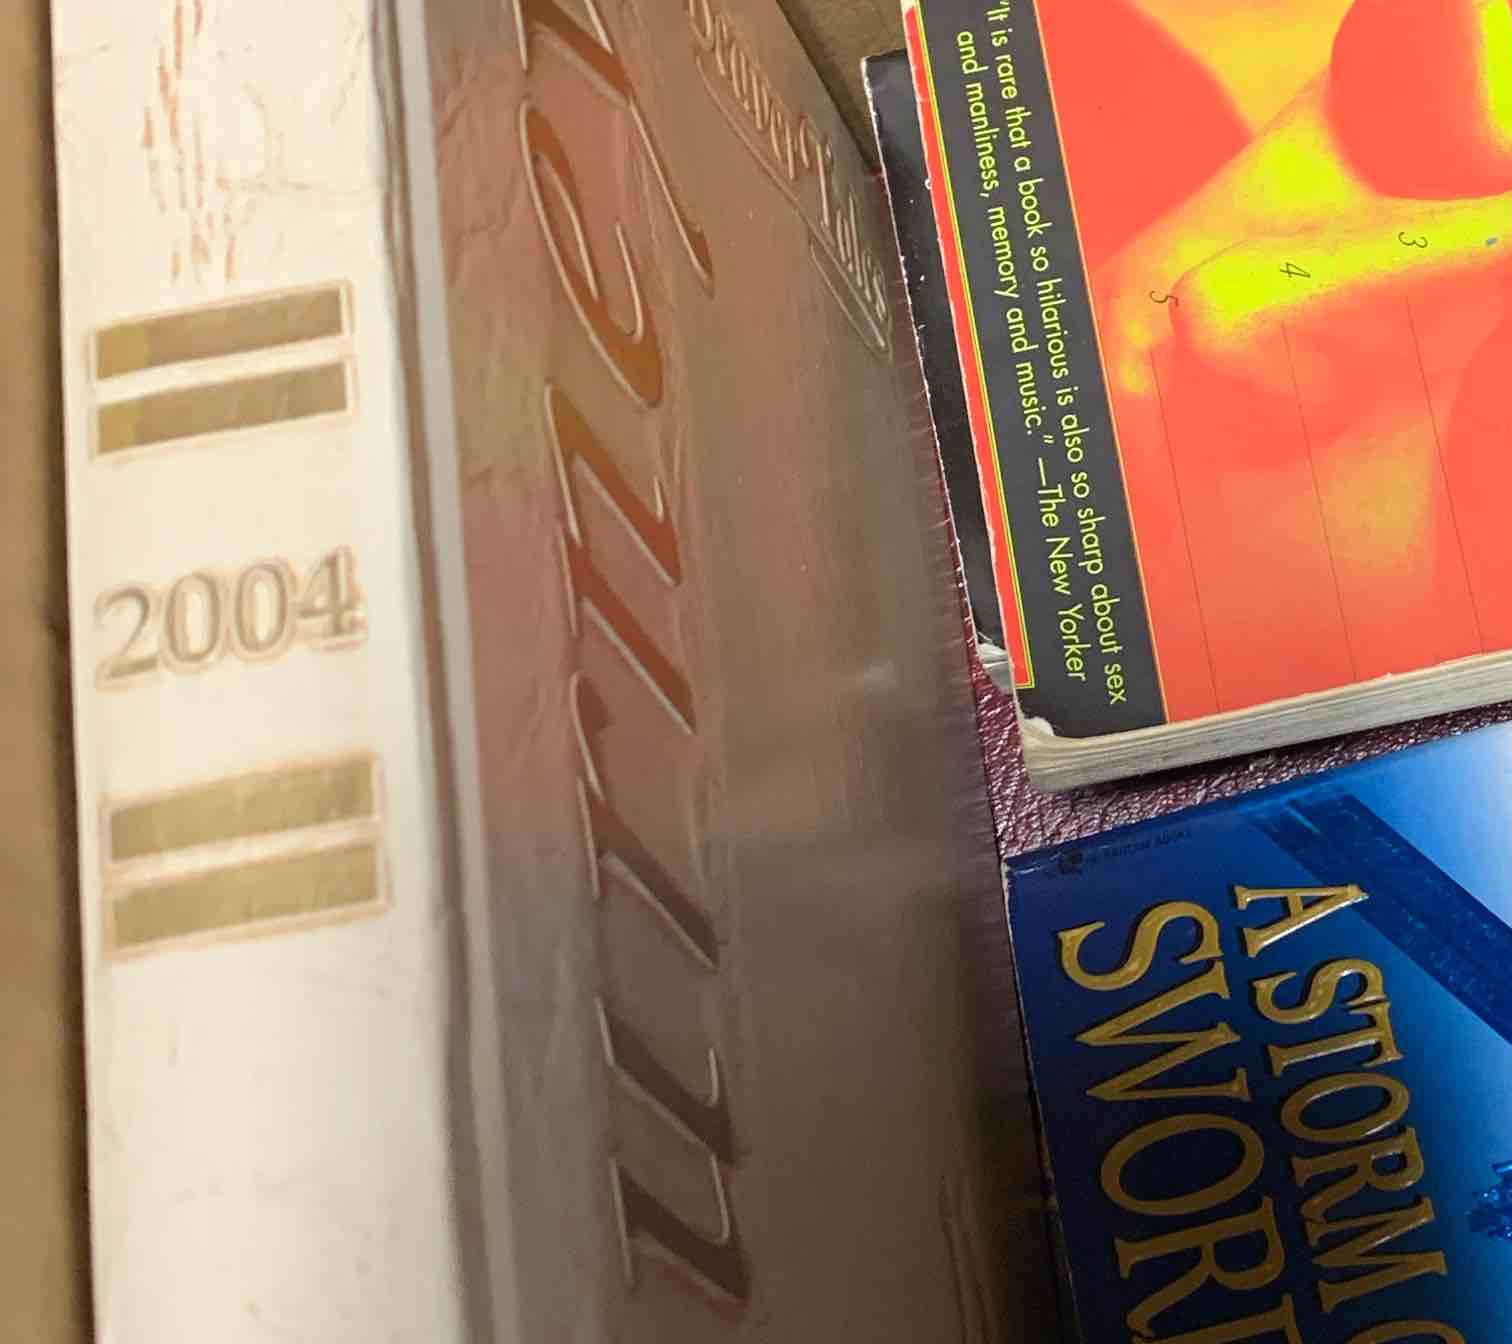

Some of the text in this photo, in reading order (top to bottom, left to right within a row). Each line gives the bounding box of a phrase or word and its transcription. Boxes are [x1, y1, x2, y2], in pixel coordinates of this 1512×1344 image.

[957, 30, 989, 75] and
[991, 27, 1013, 46] is
[995, 54, 1018, 100] rare
[965, 81, 1001, 199] manliness,
[1005, 106, 1032, 149] that
[1013, 155, 1032, 173] a
[1018, 177, 1054, 238] book
[987, 205, 1020, 300] memory
[1030, 245, 1050, 273] so
[1397, 231, 1429, 250] 3
[1279, 261, 1312, 279] 4
[1148, 288, 1180, 306] 5
[1005, 306, 1040, 354] and
[1036, 277, 1070, 380] hilarious
[1055, 385, 1080, 406] is
[1060, 413, 1091, 464] also
[1070, 471, 1091, 499] so
[1077, 506, 1107, 576] sharp
[1045, 536, 1074, 597] New
[94, 545, 369, 689] 2004
[1090, 583, 1123, 656] about
[1057, 602, 1092, 682] Yorker
[1104, 662, 1128, 705] sex
[1234, 882, 1371, 960] A
[1250, 958, 1453, 1316] STORM
